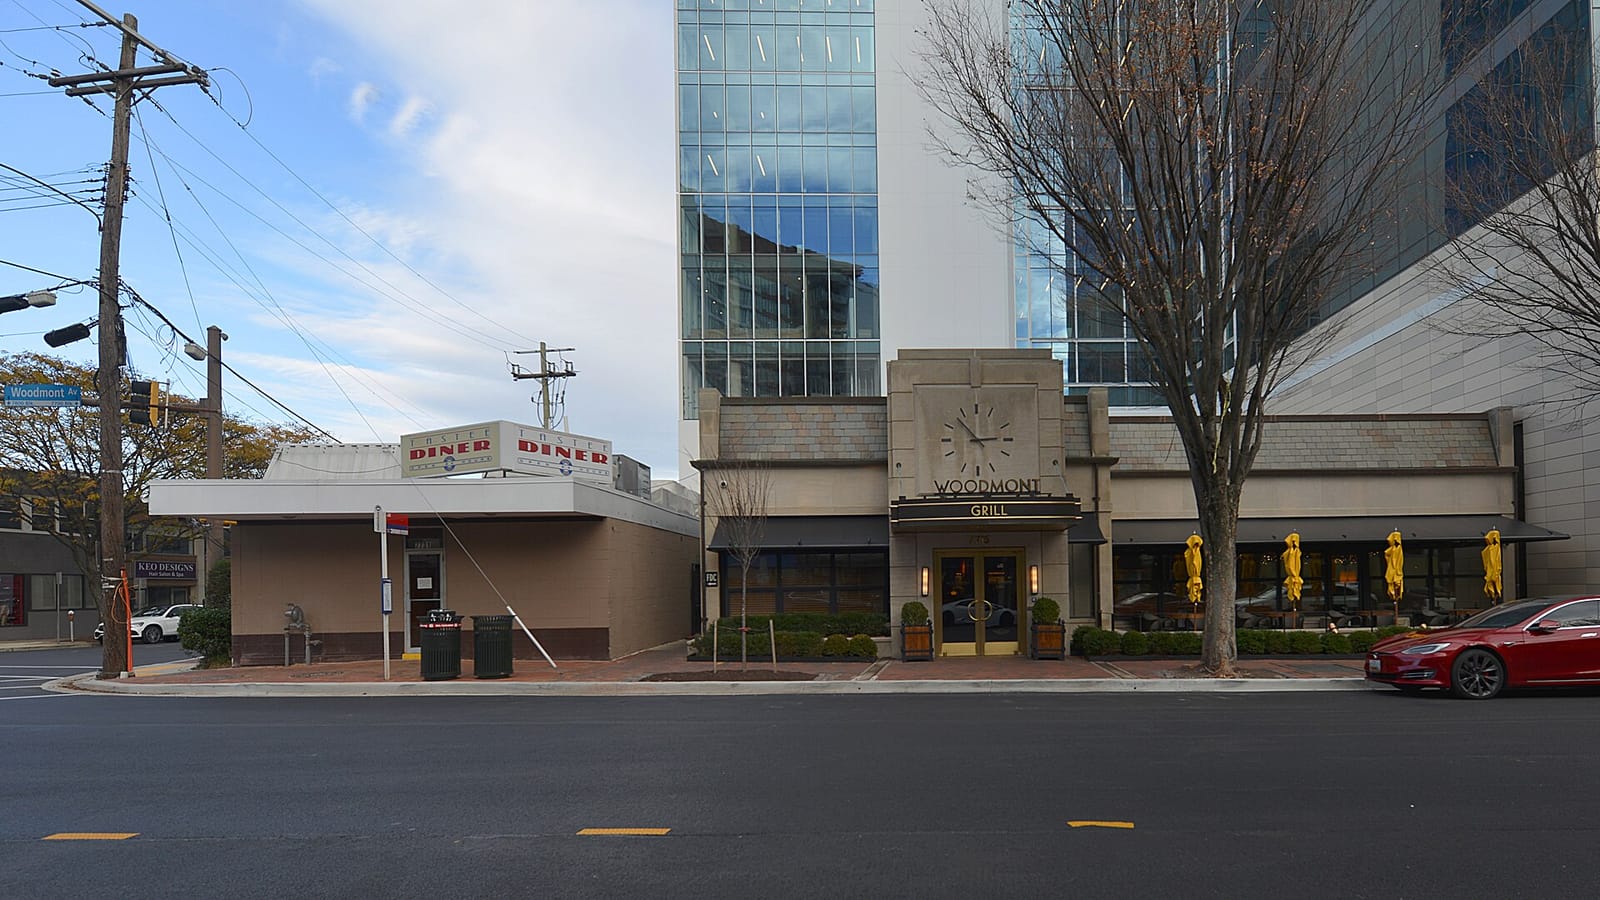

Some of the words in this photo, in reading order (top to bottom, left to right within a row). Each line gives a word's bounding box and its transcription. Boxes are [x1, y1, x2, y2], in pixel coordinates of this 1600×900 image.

[11, 387, 64, 398] Woodmont
[410, 440, 490, 460] DINER
[518, 439, 608, 464] DINER
[934, 479, 1040, 493] WOODMONT
[970, 505, 1008, 516] GRILL
[138, 562, 158, 571] KEO
[159, 563, 194, 572] DESIGNS
